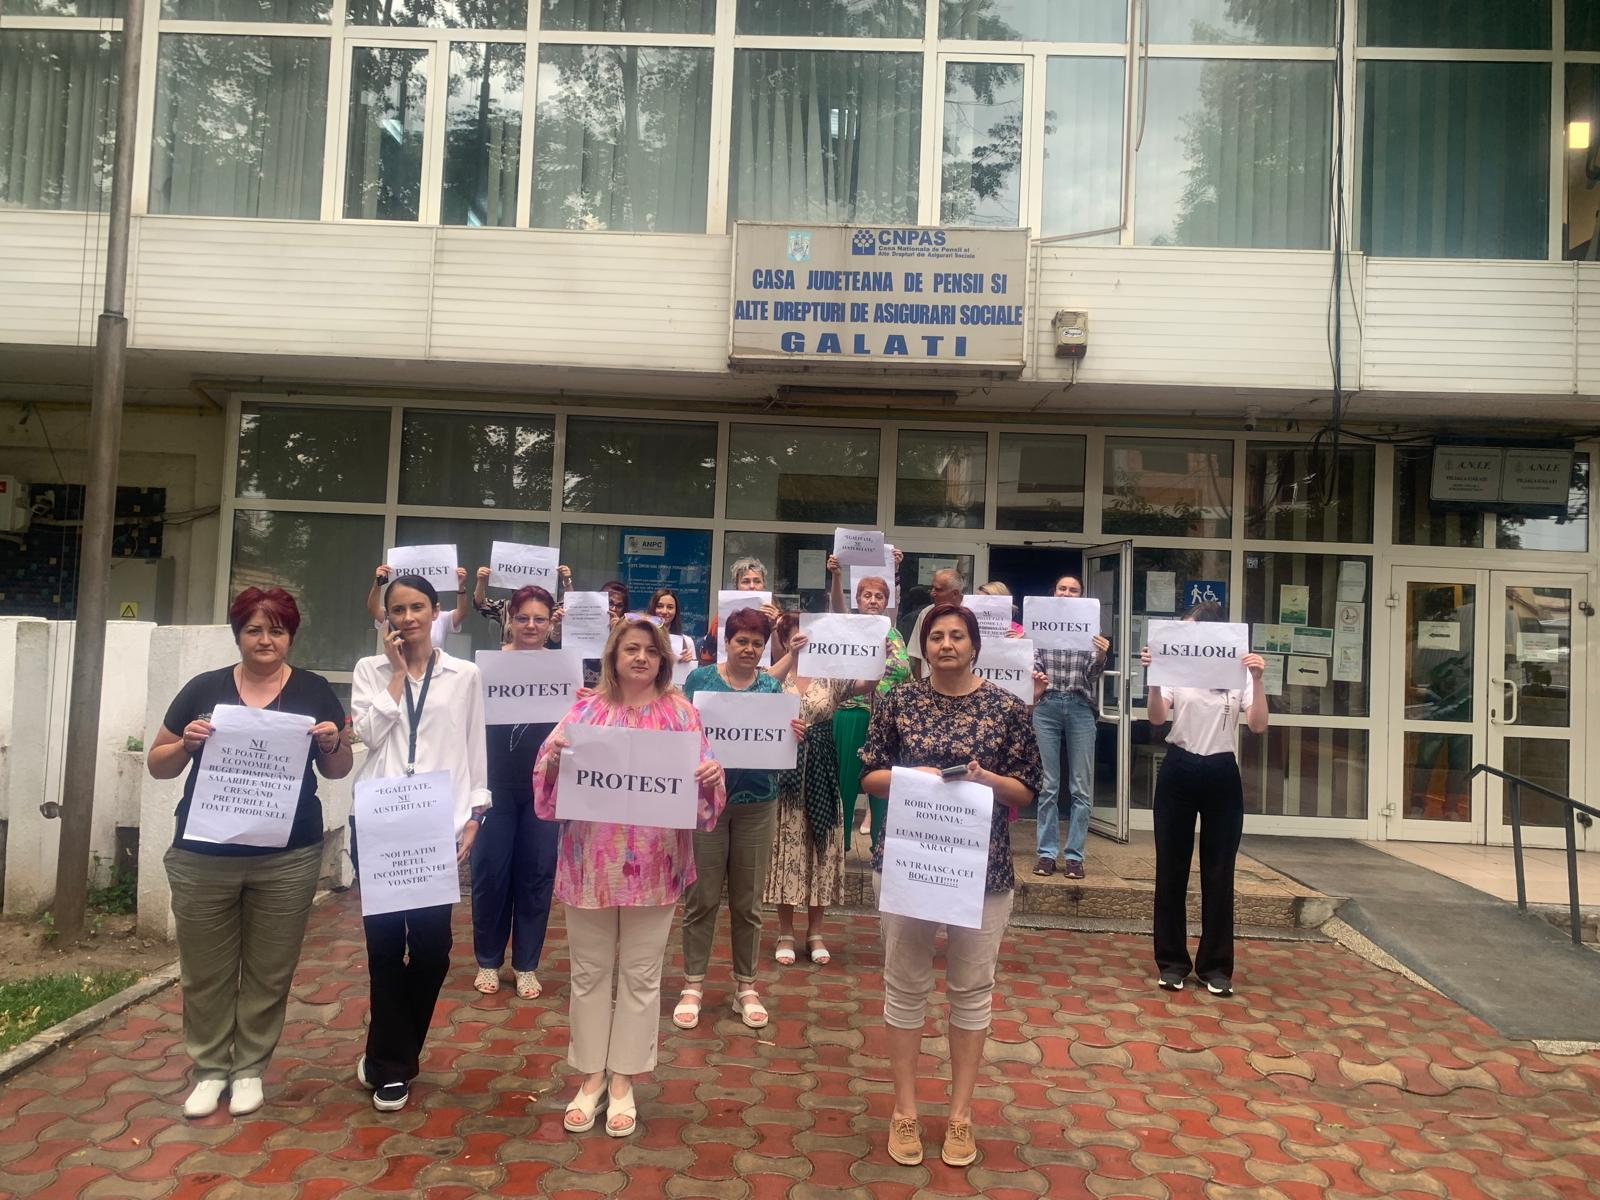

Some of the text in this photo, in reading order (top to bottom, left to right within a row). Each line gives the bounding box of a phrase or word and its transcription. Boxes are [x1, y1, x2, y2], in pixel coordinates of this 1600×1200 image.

[878, 230, 946, 246] CNPAS
[752, 269, 1007, 294] CASA JUDETEANA DE PENSII SI
[735, 300, 1023, 325] ALTE DREPTURI DE ASIGURARI SOCIALE
[781, 331, 967, 357] GALATI
[396, 566, 450, 577] PROTEST
[498, 563, 551, 577] PROTEST
[1031, 621, 1091, 633] PROTEST
[808, 642, 880, 657] PROTEST
[972, 667, 1024, 681] OTEST
[487, 683, 571, 698] PROTEST
[704, 726, 786, 742] PROTEST
[251, 739, 268, 749] NU
[221, 747, 291, 763] SE POATE FACE
[208, 764, 241, 775] BUGET
[222, 757, 286, 772] ECONOMIE LA
[208, 775, 258, 788] SALARIILE
[259, 781, 281, 790] MICI
[576, 769, 683, 795] PROTEST
[266, 801, 279, 809] LA
[398, 794, 410, 802] NU
[200, 802, 231, 813] TOATE
[904, 799, 977, 816] ROBIN HOOD DE
[916, 811, 963, 825] ROMANIA:
[896, 828, 980, 848] LUAM DOAR DE LA
[402, 846, 436, 858] PLATIM
[920, 842, 954, 854] SARACI
[895, 859, 974, 878] SA TRAIASCA CEI
